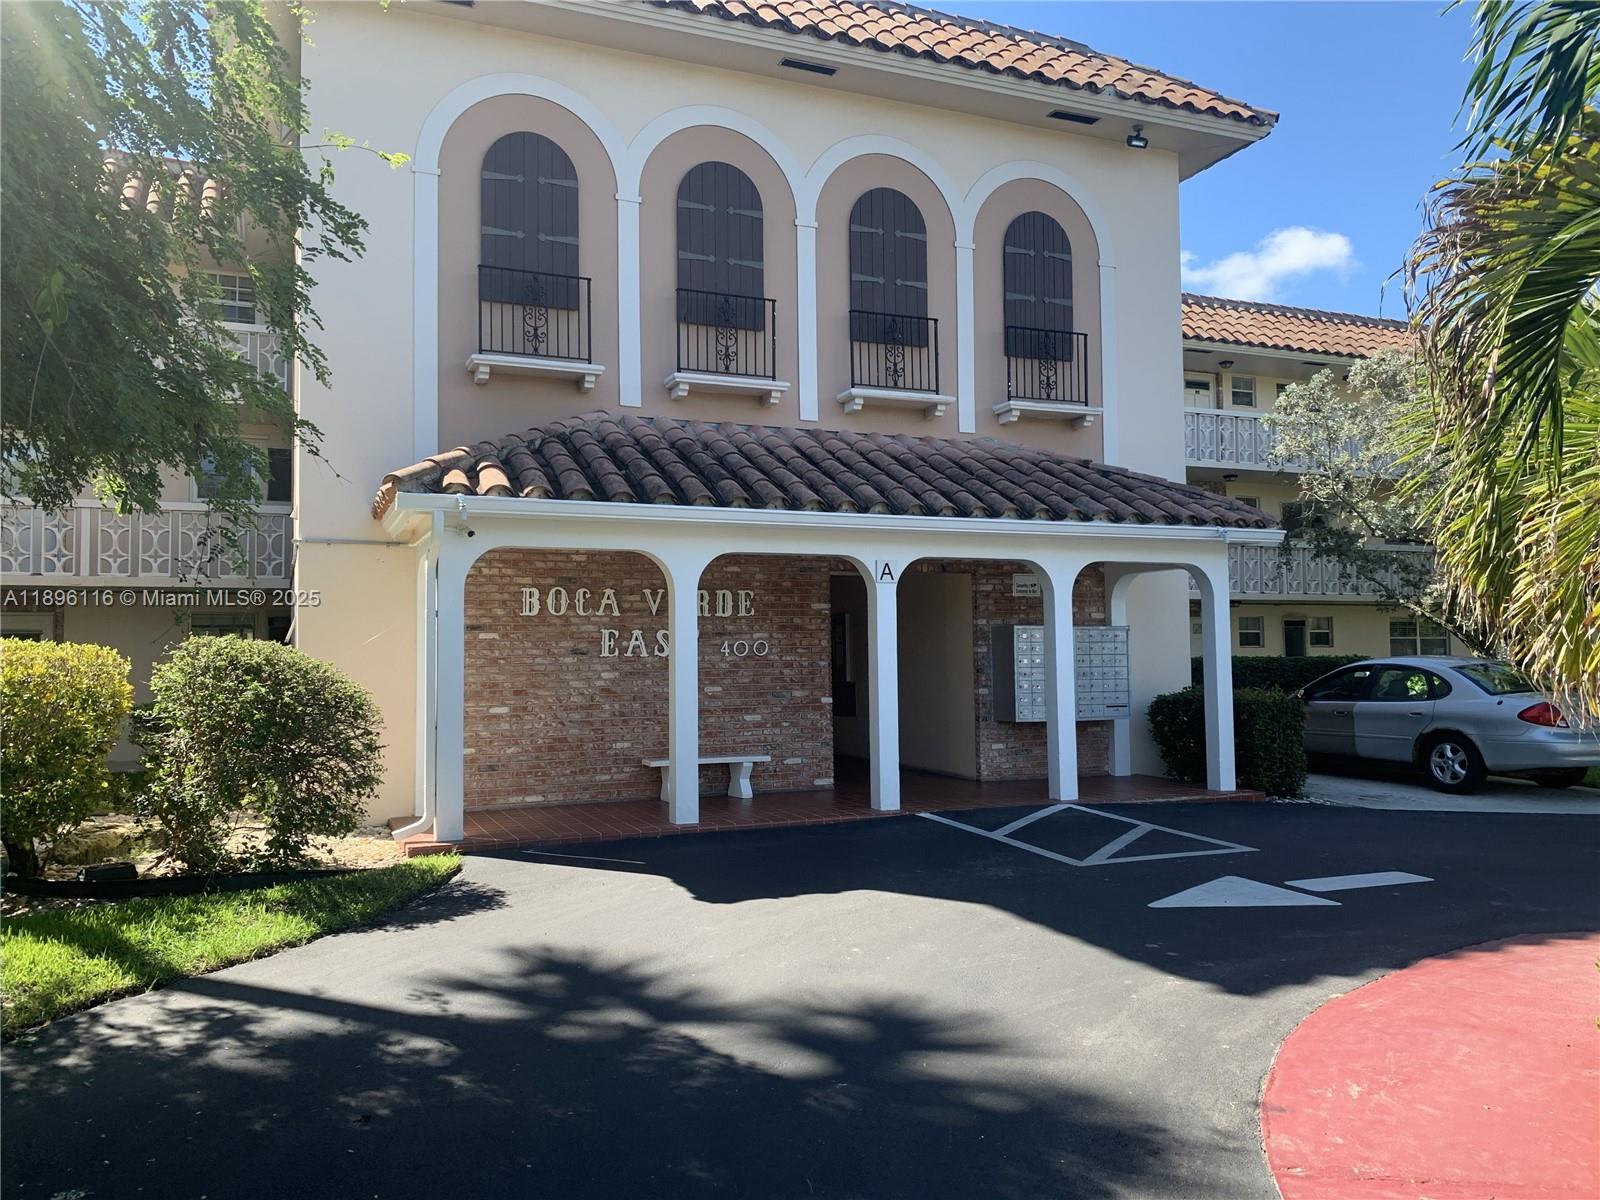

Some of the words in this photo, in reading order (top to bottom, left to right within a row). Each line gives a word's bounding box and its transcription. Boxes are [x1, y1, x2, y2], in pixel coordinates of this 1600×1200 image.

[880, 562, 895, 581] A
[520, 587, 621, 616] BOCA
[642, 589, 755, 617] VRDE
[600, 629, 699, 657] EAS
[721, 640, 768, 656] 400
